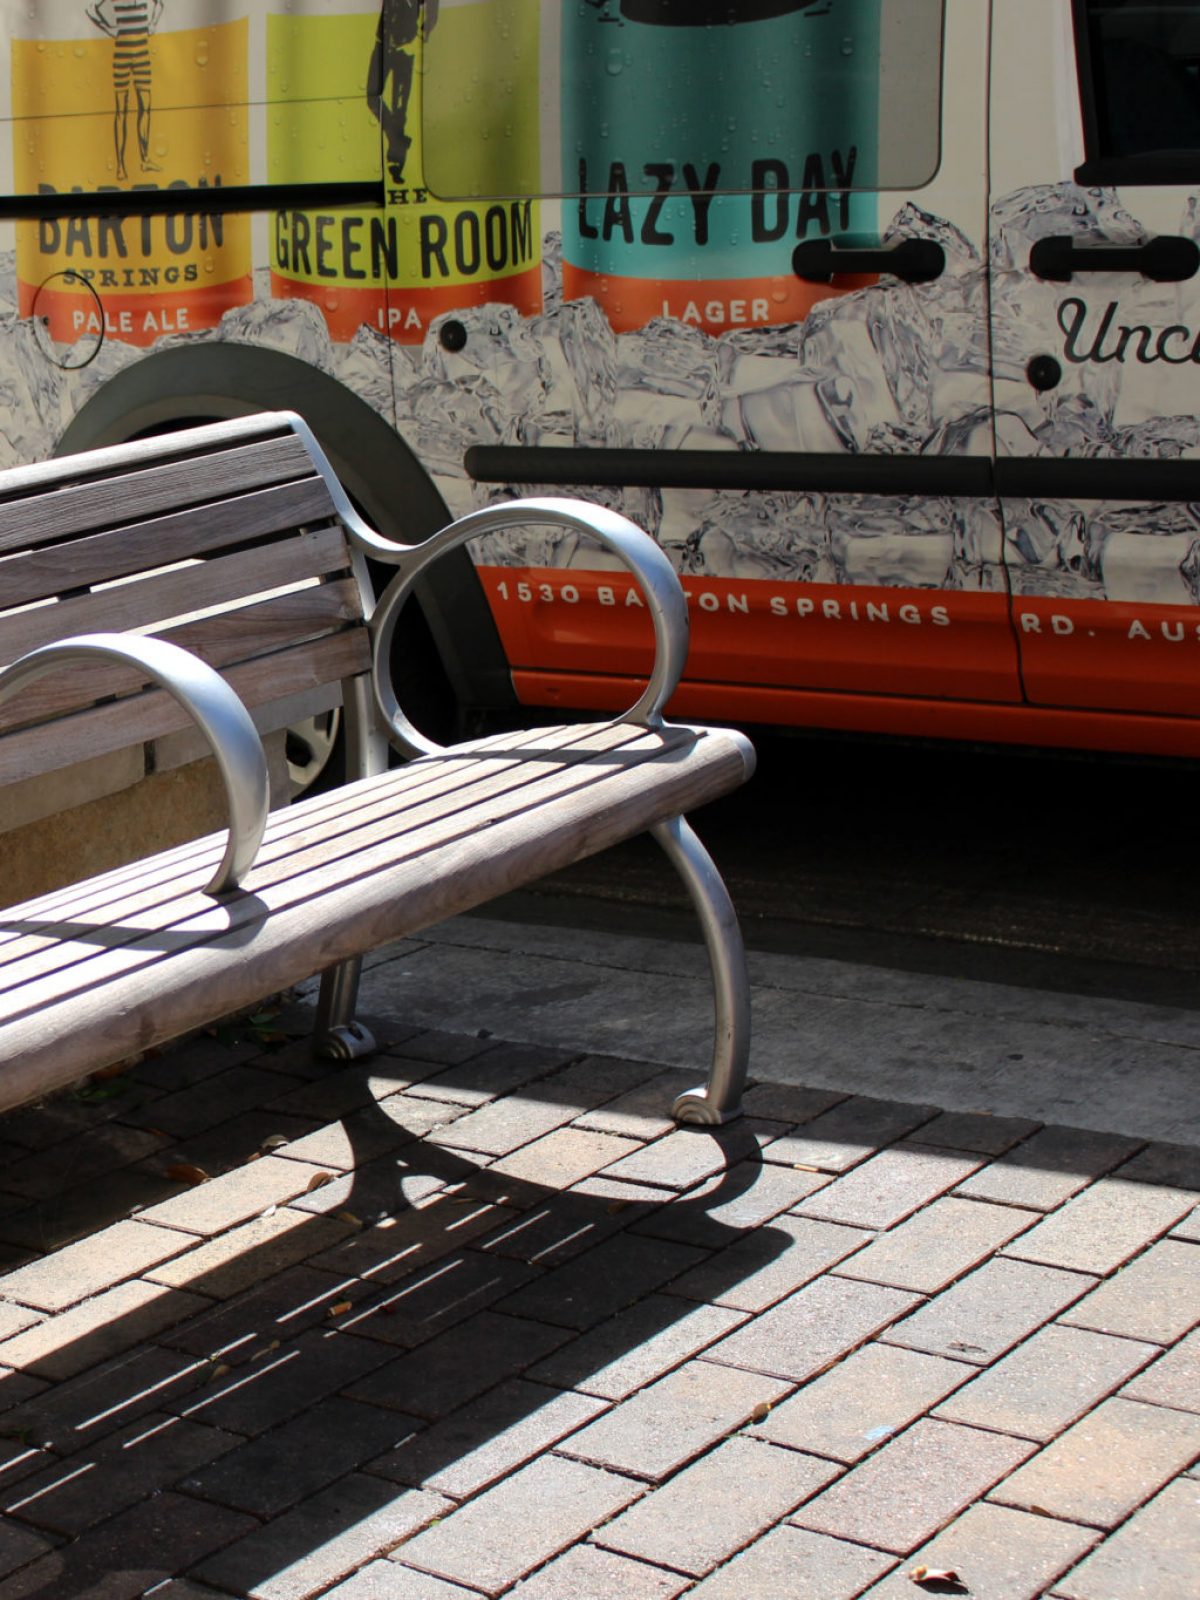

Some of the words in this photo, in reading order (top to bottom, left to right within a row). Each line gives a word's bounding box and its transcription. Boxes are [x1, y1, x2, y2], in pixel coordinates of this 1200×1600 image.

[37, 173, 224, 258] BARTON
[386, 187, 429, 206] HE
[578, 157, 722, 246] LAZY
[750, 145, 858, 244] DAY
[275, 206, 399, 280] GREEN
[418, 199, 533, 279] ROOM
[62, 263, 199, 288] SPRINGS
[71, 309, 134, 333] PALE
[142, 307, 190, 333] ALE
[377, 307, 423, 330] IPA
[661, 298, 770, 324] LAGER
[1056, 297, 1200, 364] Unc
[497, 581, 580, 603] 1530
[597, 585, 749, 614] BAON
[769, 596, 951, 627] SPRINGS
[1020, 612, 1096, 637] RD.
